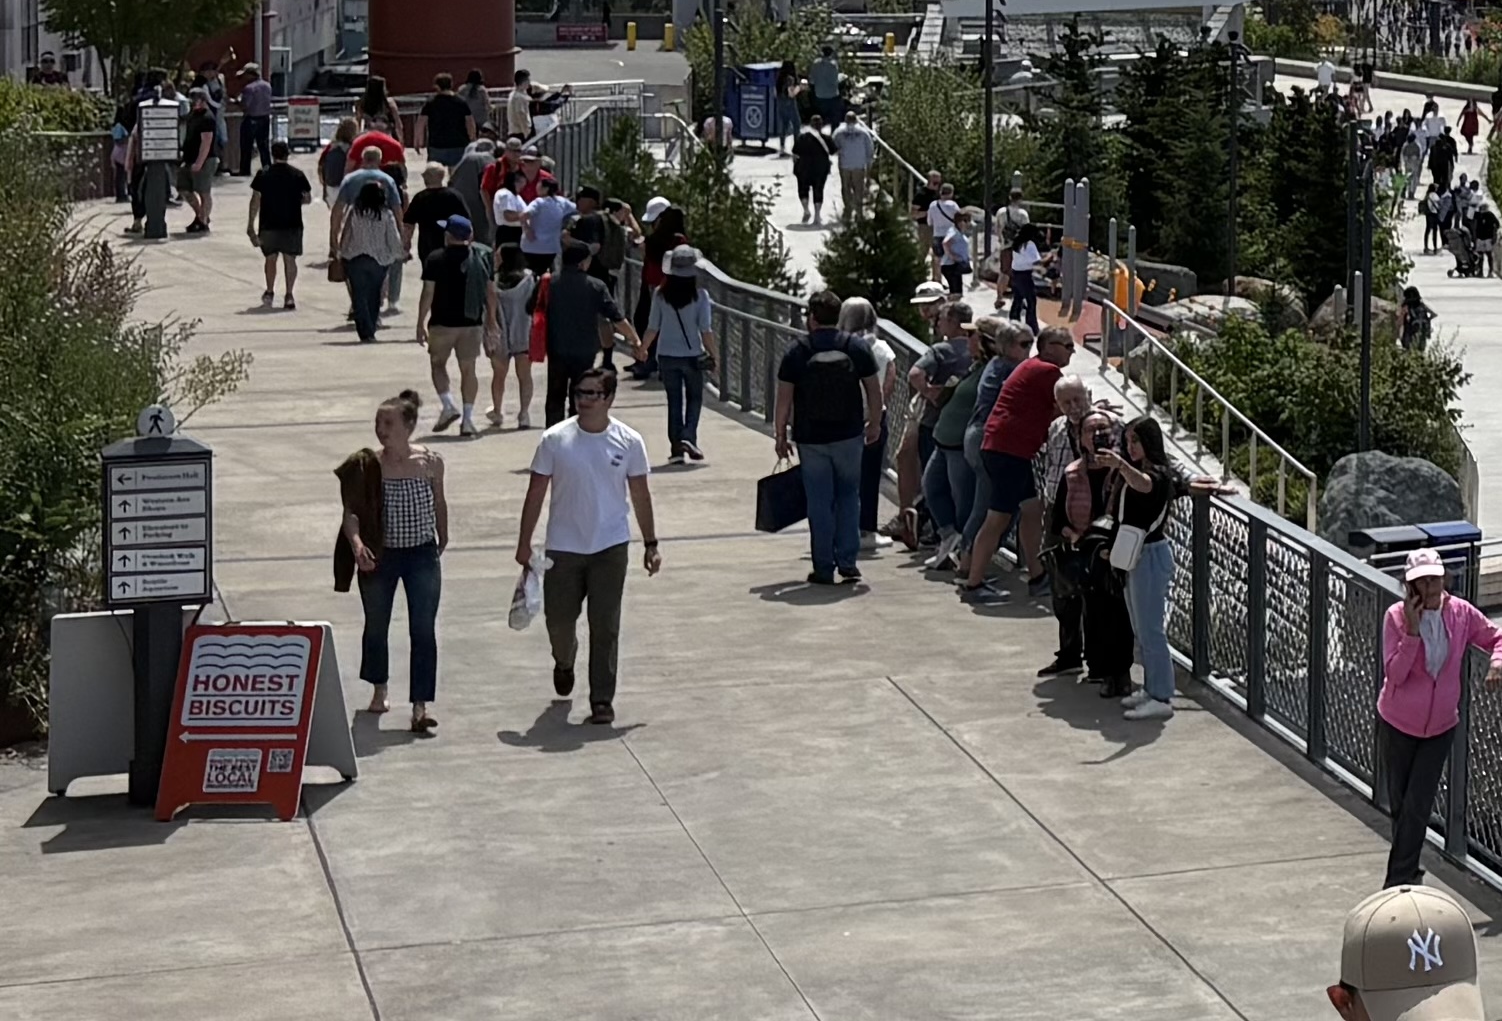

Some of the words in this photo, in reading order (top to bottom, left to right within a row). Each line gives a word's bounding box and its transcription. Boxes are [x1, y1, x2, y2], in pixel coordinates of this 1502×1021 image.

[192, 674, 300, 692] HONEST
[188, 699, 296, 716] BISCUITS
[207, 771, 254, 784] LOCAL
[1407, 927, 1443, 971] NY
